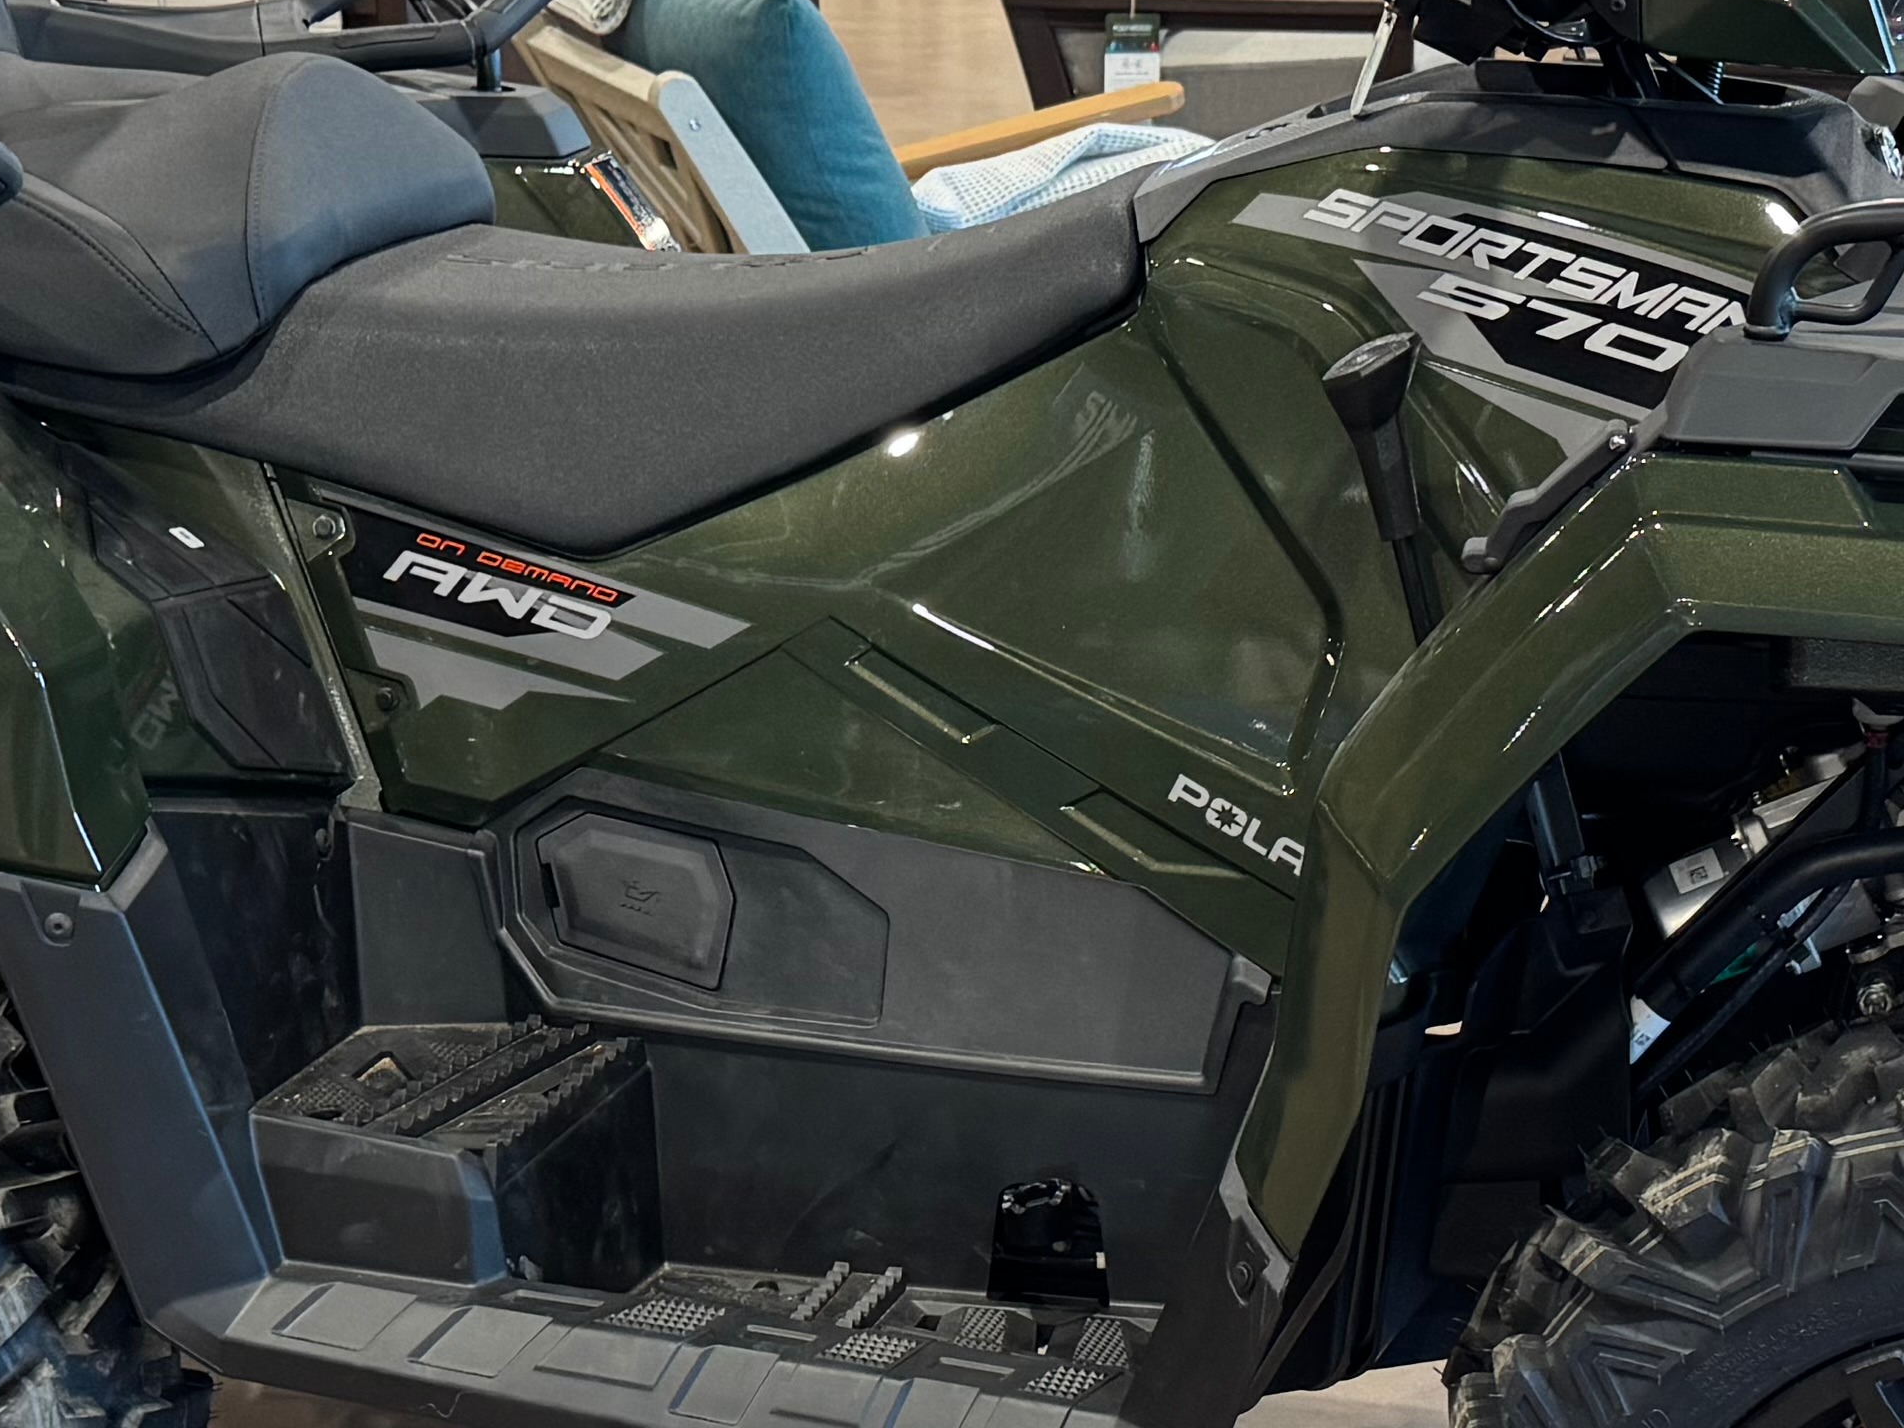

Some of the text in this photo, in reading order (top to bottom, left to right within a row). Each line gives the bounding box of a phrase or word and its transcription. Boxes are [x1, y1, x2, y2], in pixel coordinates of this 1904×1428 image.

[1416, 274, 1689, 372] 570
[383, 550, 612, 640] AWD
[476, 551, 618, 603] DEMAND
[1168, 774, 1306, 877] POLA
